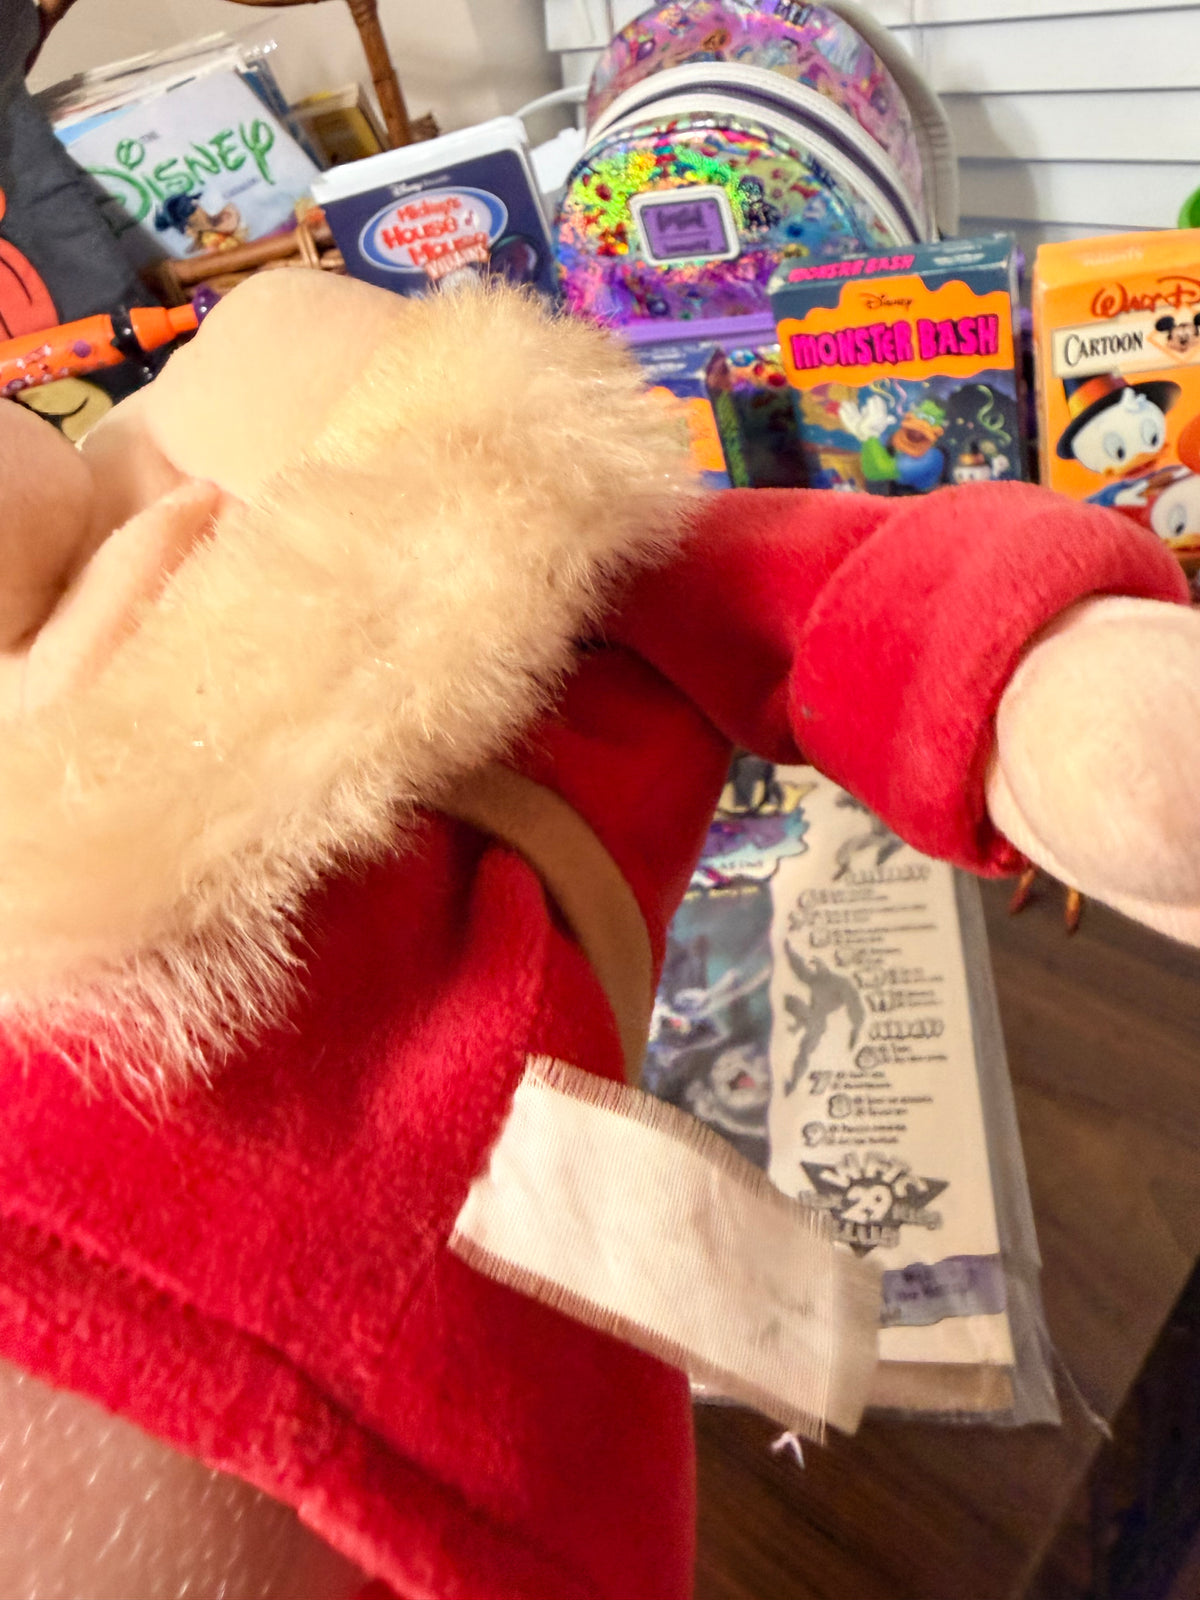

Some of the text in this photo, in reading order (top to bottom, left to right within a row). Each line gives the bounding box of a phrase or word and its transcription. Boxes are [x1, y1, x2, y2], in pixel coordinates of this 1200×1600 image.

[382, 216, 459, 250] House
[790, 313, 999, 370] MONSTER BASH
[1063, 332, 1144, 367] CARTOON
